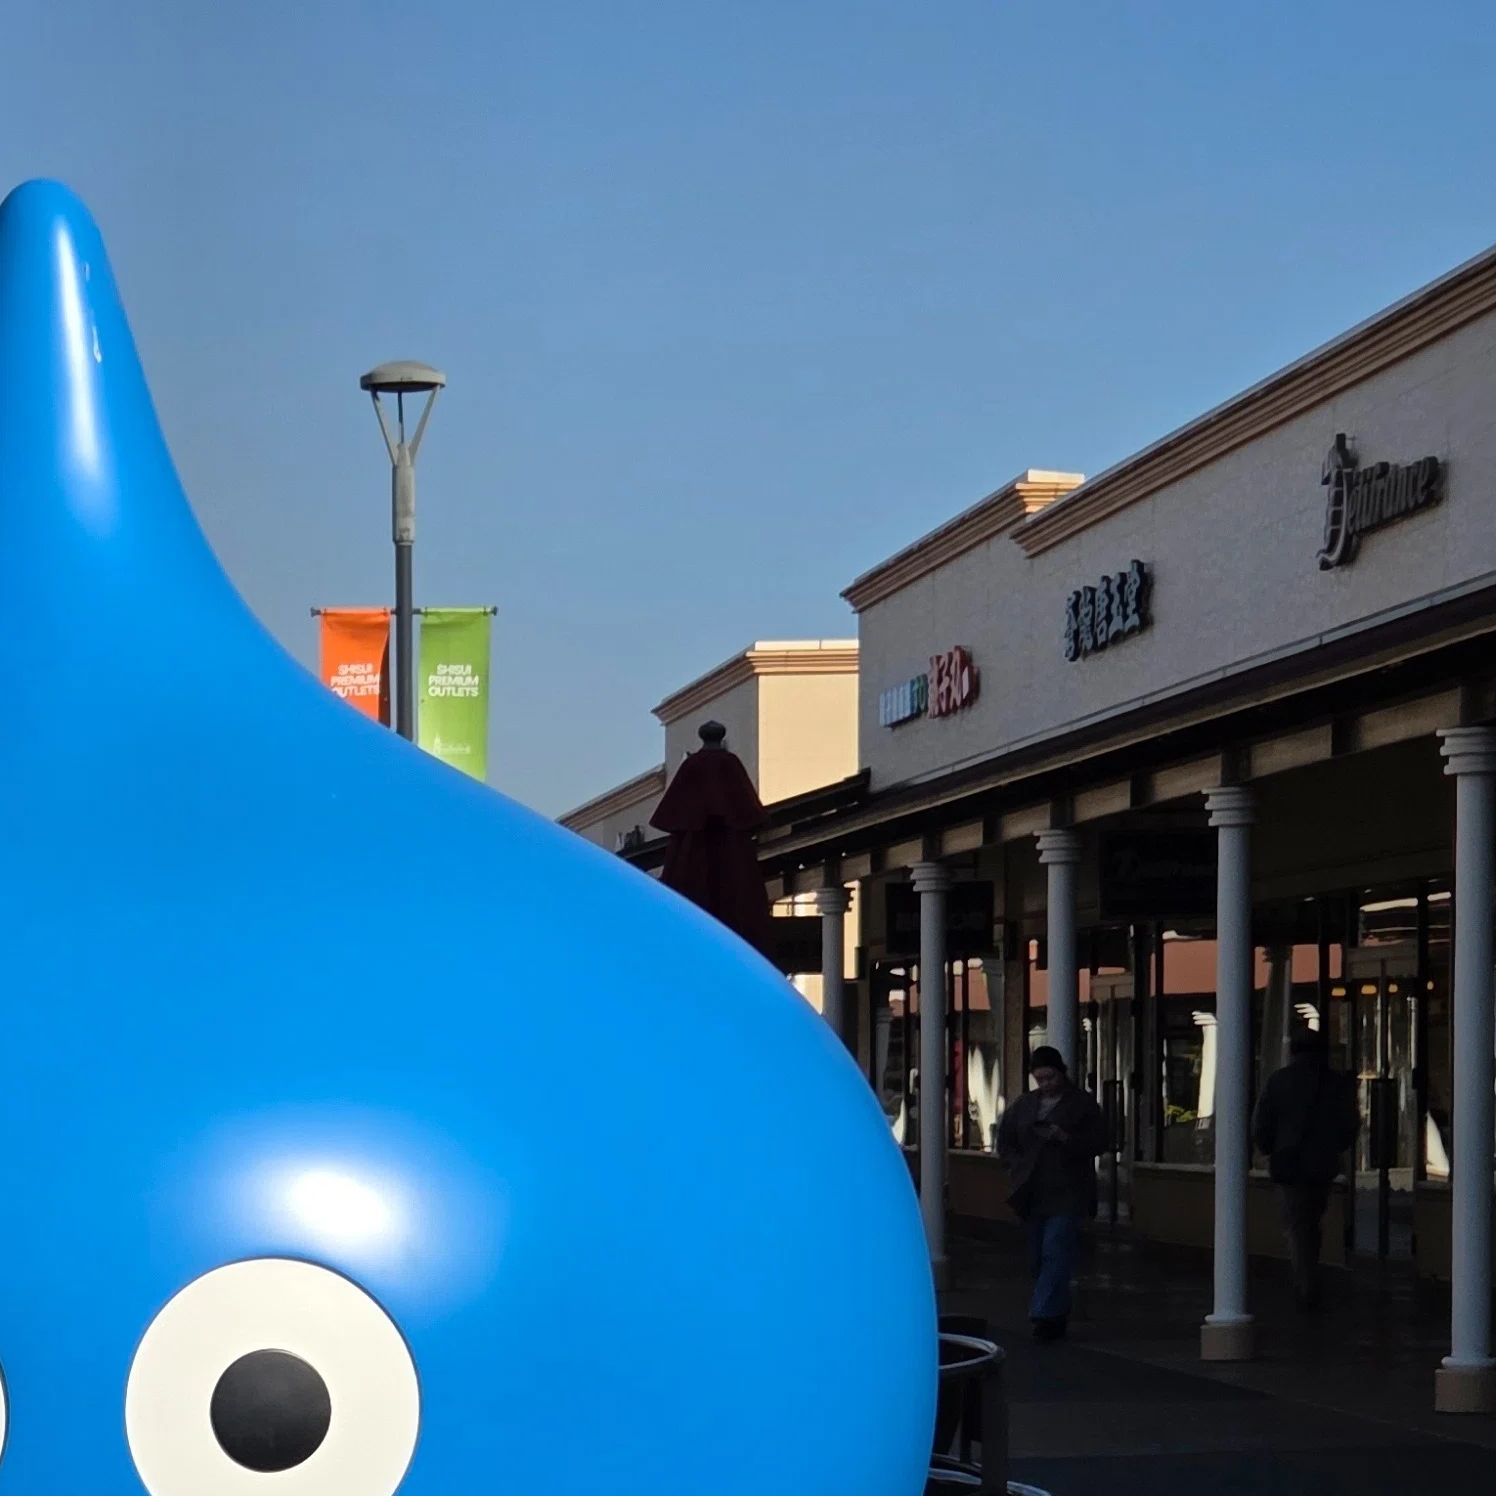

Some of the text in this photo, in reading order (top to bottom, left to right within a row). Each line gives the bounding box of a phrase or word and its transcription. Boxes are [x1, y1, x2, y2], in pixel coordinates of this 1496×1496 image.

[436, 664, 472, 675] SHISUI
[330, 673, 380, 687] PREMIUM
[428, 675, 479, 686] PREMIUM
[428, 686, 479, 697] OUTLETS
